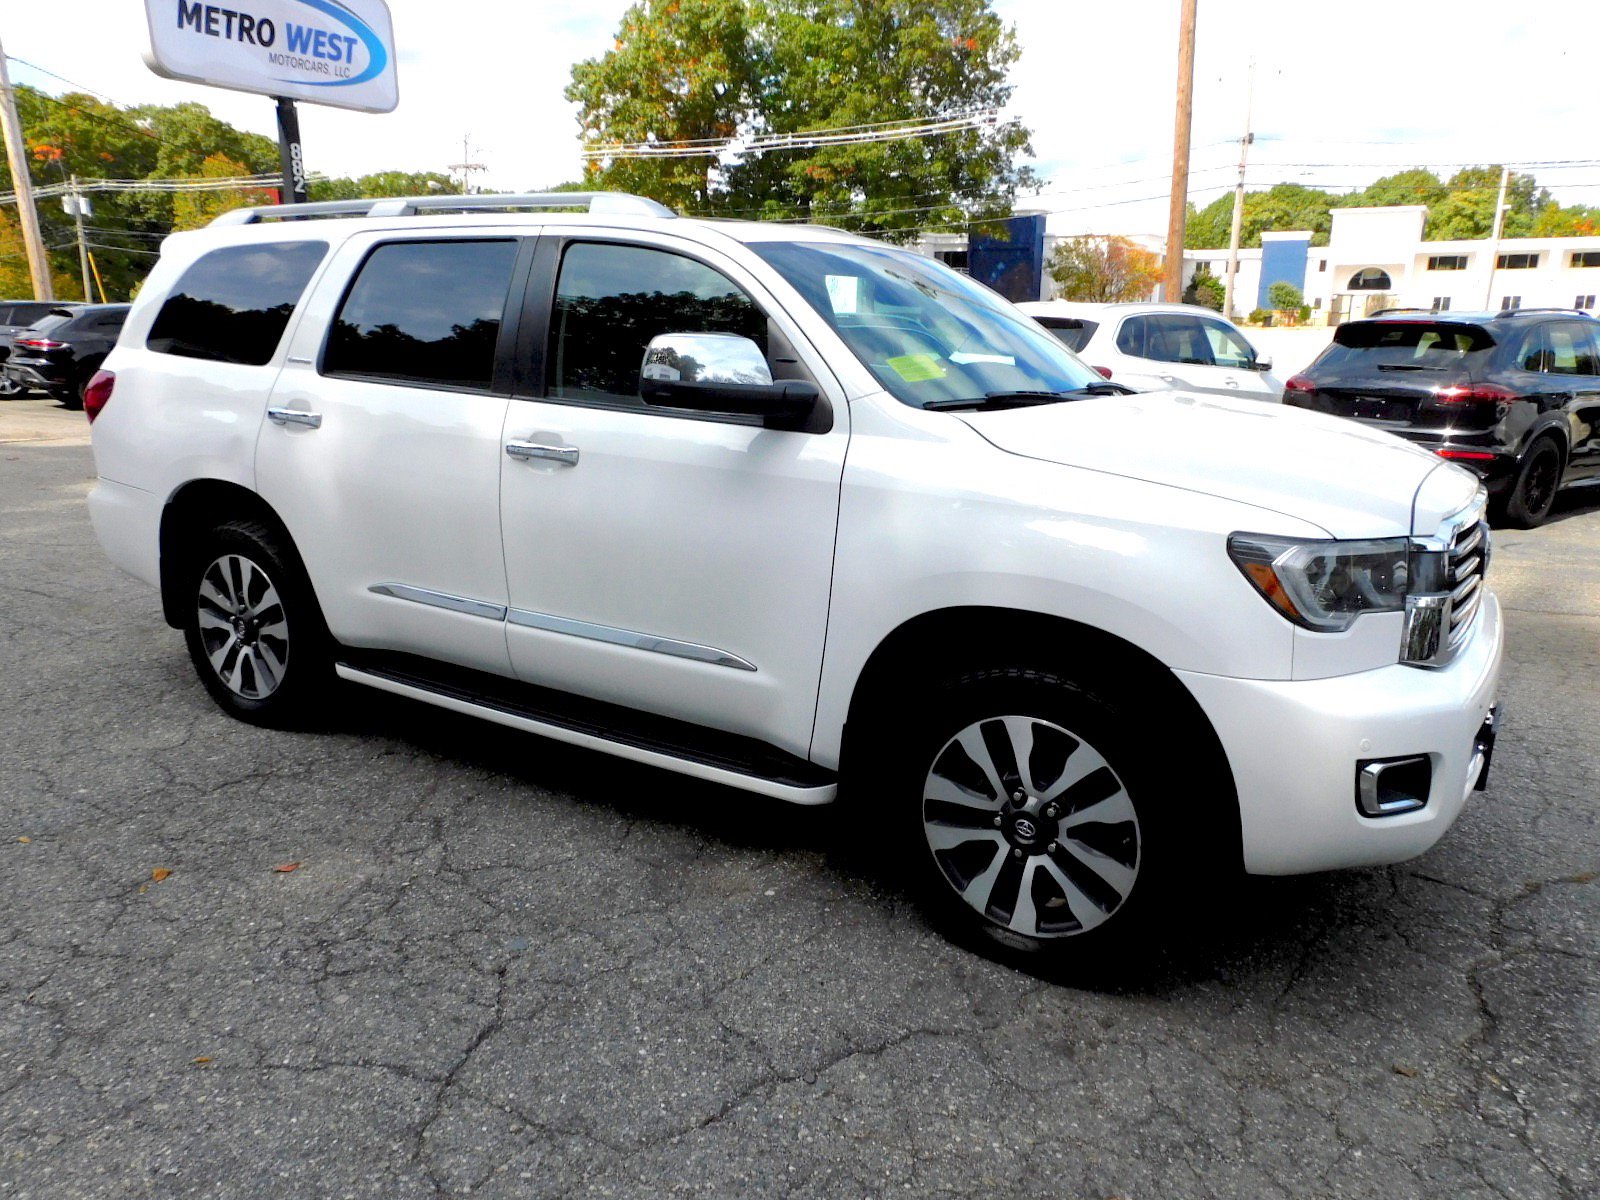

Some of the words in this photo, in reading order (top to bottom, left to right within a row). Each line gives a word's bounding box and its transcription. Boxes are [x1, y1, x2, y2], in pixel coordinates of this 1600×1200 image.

[177, 0, 275, 47] METRO
[286, 22, 358, 64] WEST
[334, 65, 351, 78] LLC
[290, 142, 306, 193] 882
